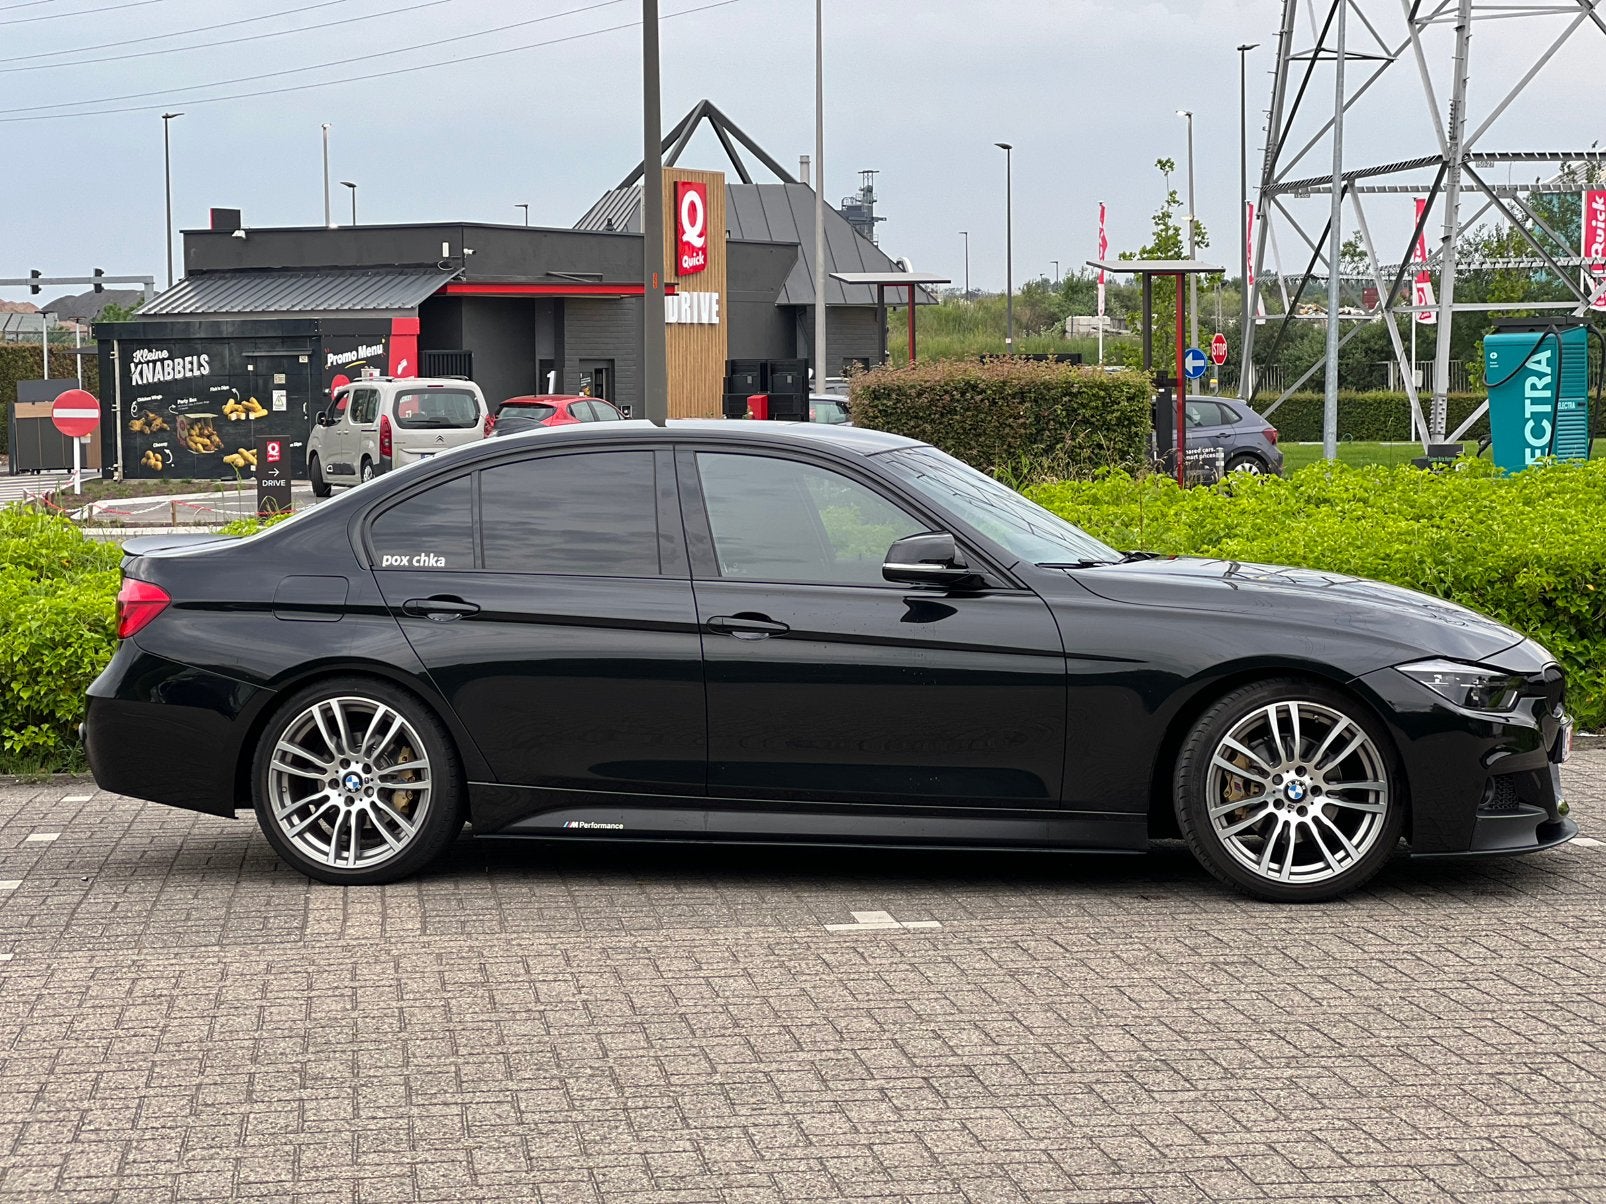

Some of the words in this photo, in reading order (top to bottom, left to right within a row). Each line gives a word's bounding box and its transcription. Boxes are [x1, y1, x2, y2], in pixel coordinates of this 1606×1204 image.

[681, 190, 705, 248] Q
[682, 251, 704, 269] Quick
[665, 292, 719, 324] DRIVE
[133, 348, 169, 363] Kleine
[327, 350, 358, 367] Promo
[357, 343, 383, 359] Menu
[1213, 343, 1227, 356] STOP
[130, 354, 209, 386] KNABBELS
[546, 370, 557, 395] 1
[262, 479, 286, 487] DRIVE
[382, 555, 410, 567] pox
[412, 552, 446, 567] chka
[579, 821, 624, 829] Performance
